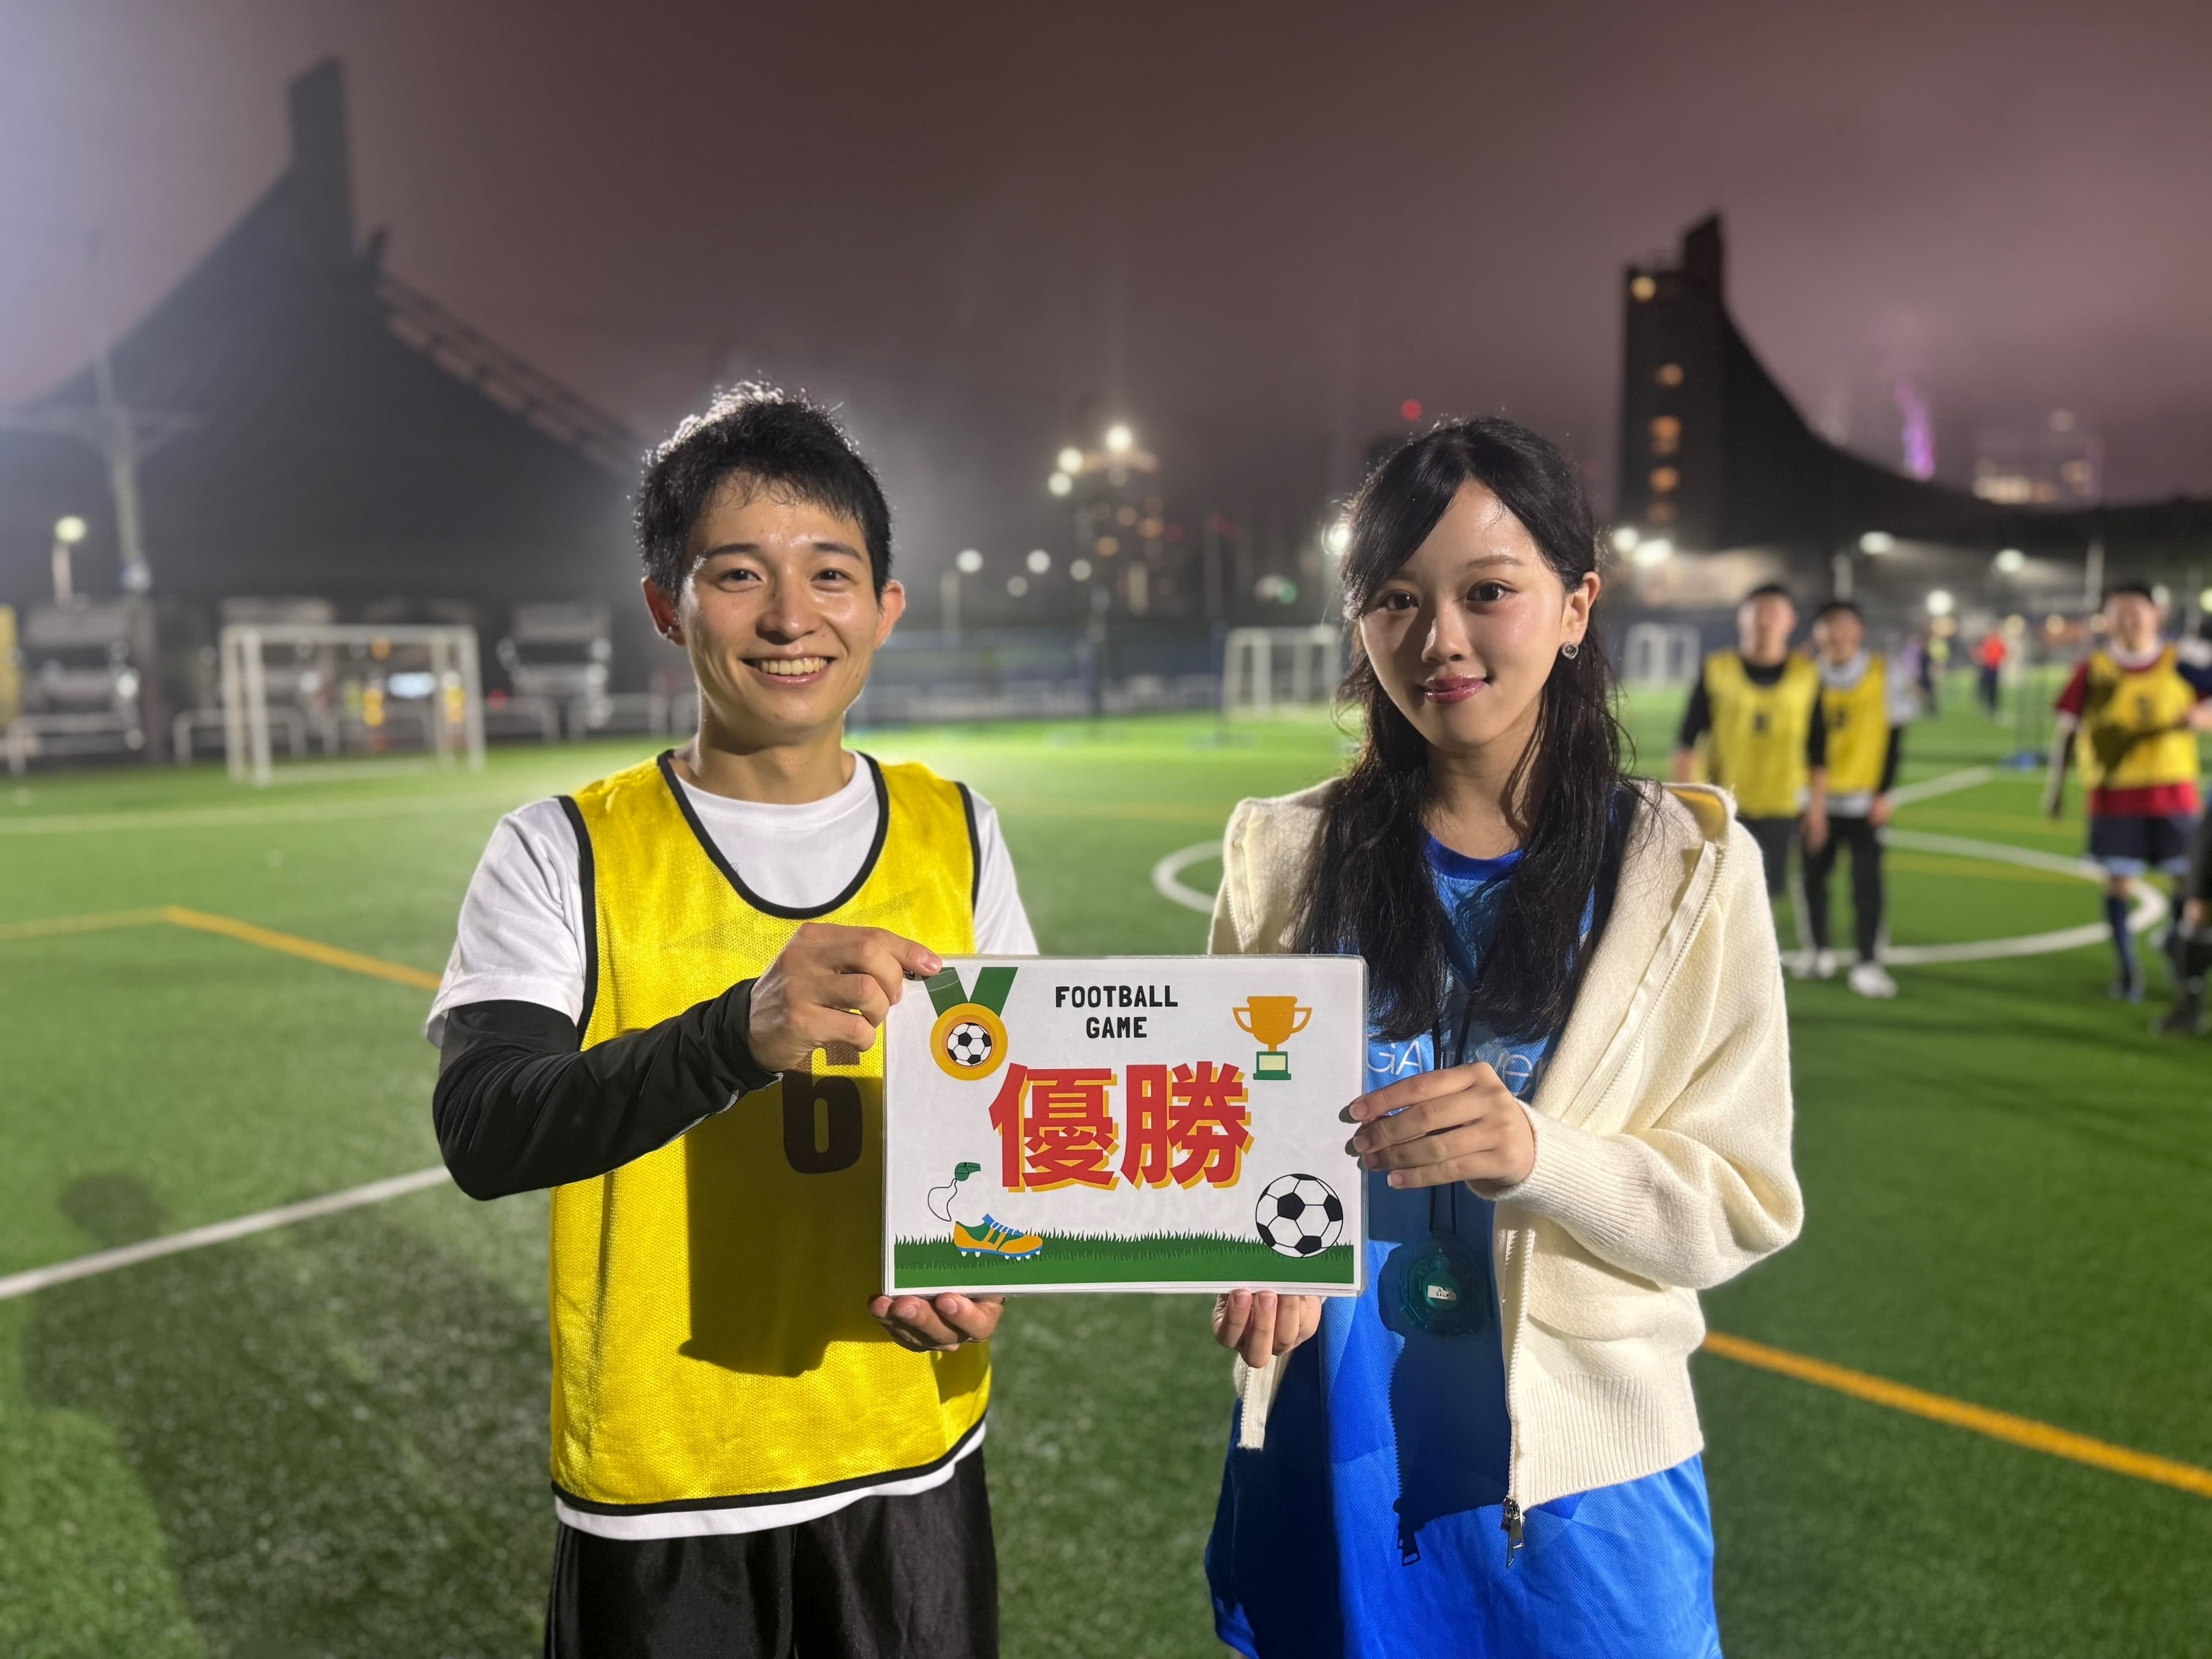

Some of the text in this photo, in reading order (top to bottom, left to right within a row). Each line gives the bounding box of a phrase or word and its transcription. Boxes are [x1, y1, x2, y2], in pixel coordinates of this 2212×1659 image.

[1055, 986, 1178, 1008] FOOTBALL
[1086, 1017, 1147, 1039] GAME
[782, 1041, 863, 1173] 6
[989, 1061, 1254, 1192] 優勝
